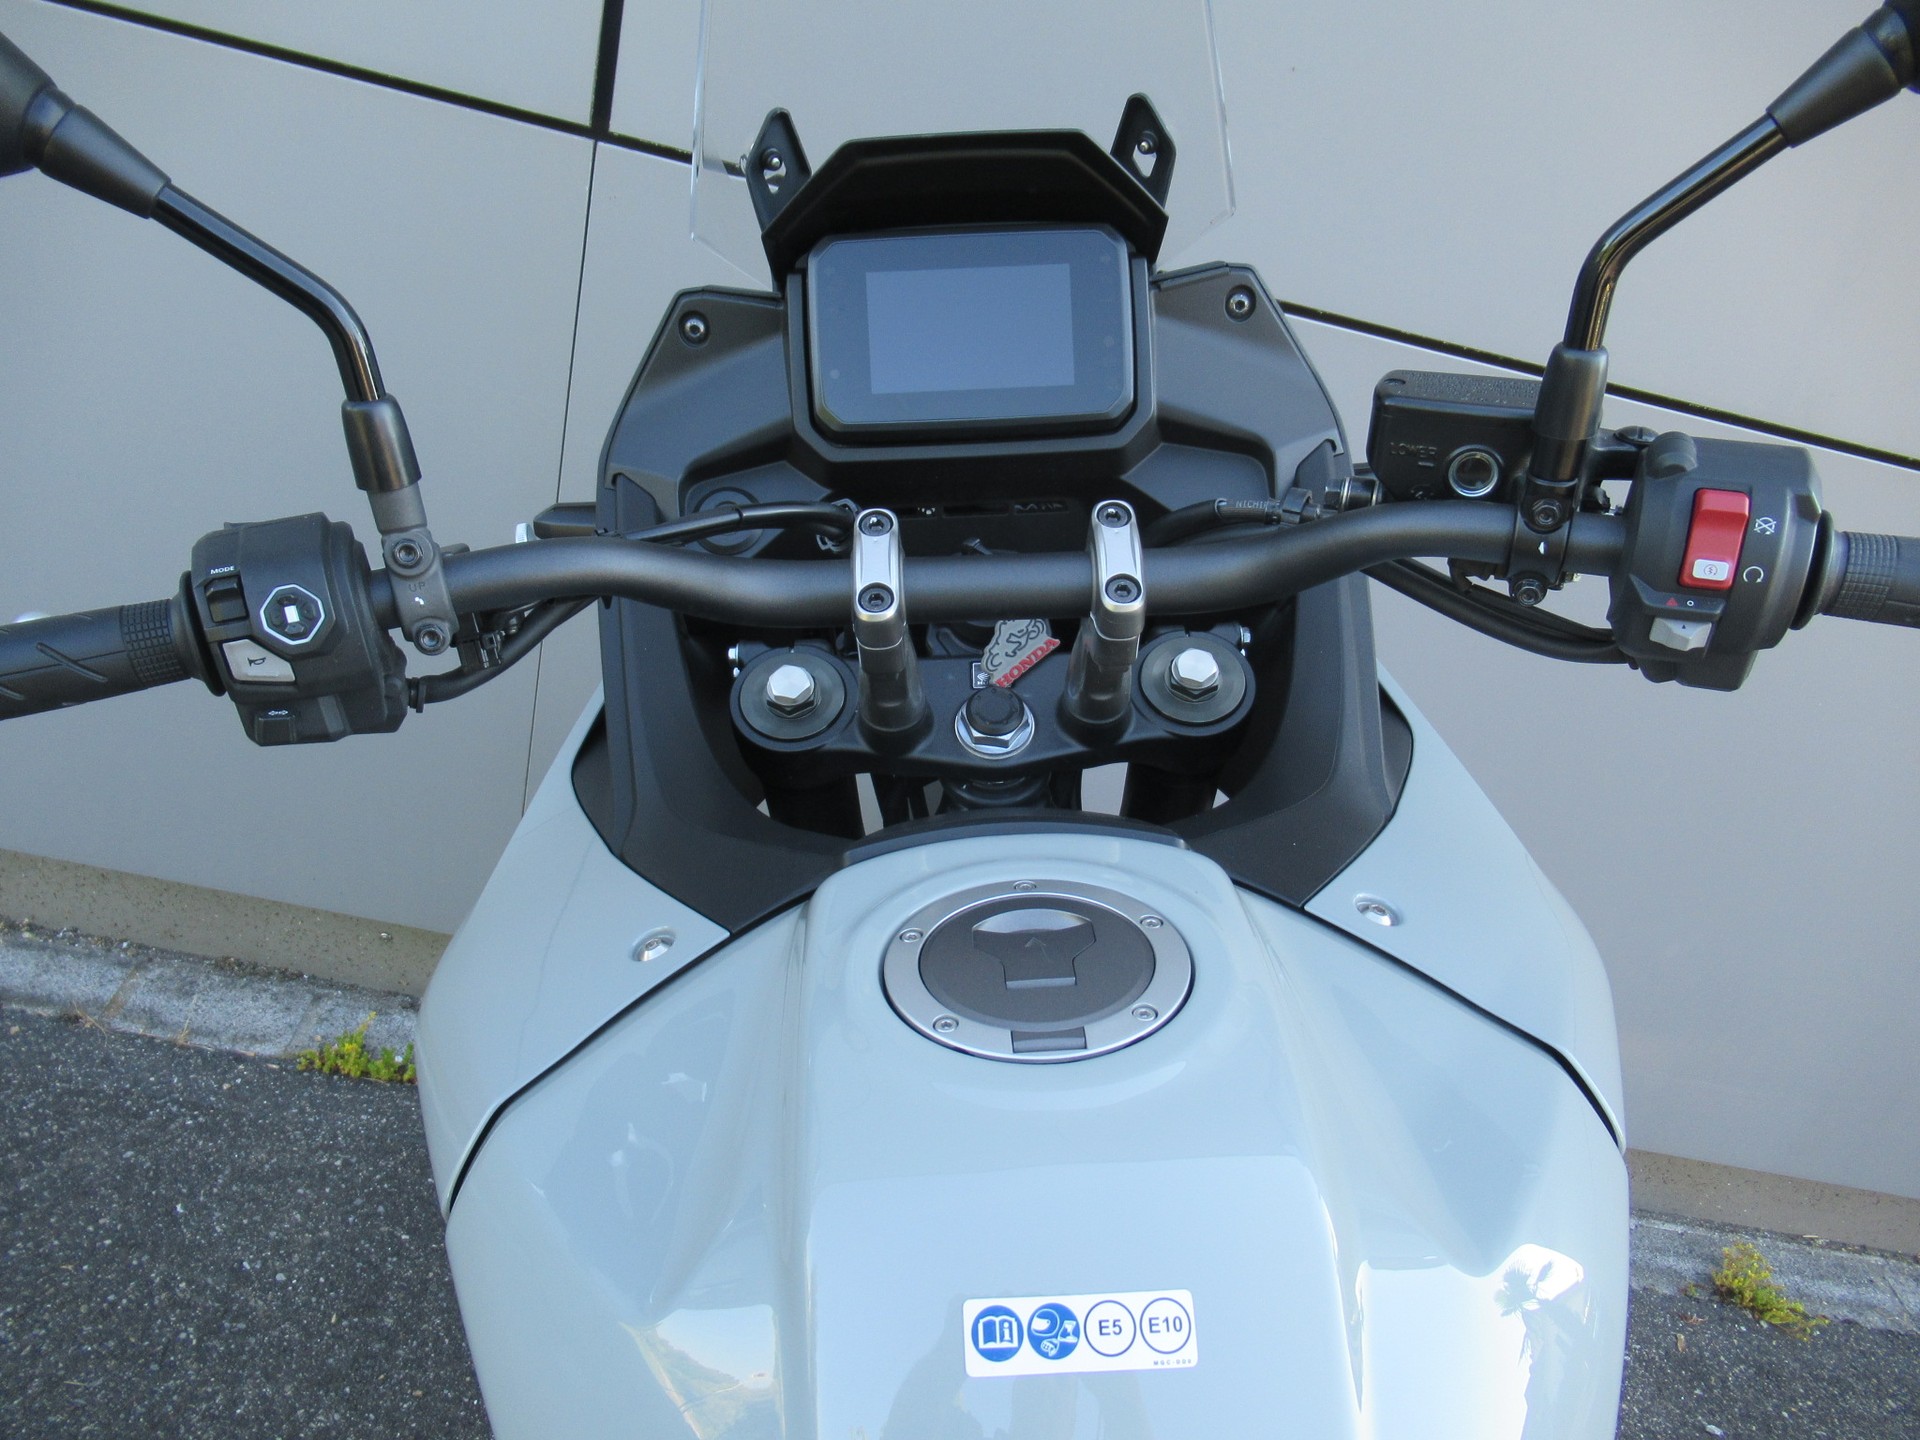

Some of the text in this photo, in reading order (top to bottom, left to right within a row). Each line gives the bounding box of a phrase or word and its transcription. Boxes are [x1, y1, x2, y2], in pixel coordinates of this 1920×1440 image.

[210, 565, 235, 575] MODE
[408, 581, 425, 592] UP
[994, 638, 1058, 688] HONDA
[1098, 1316, 1183, 1336] E5 E10
